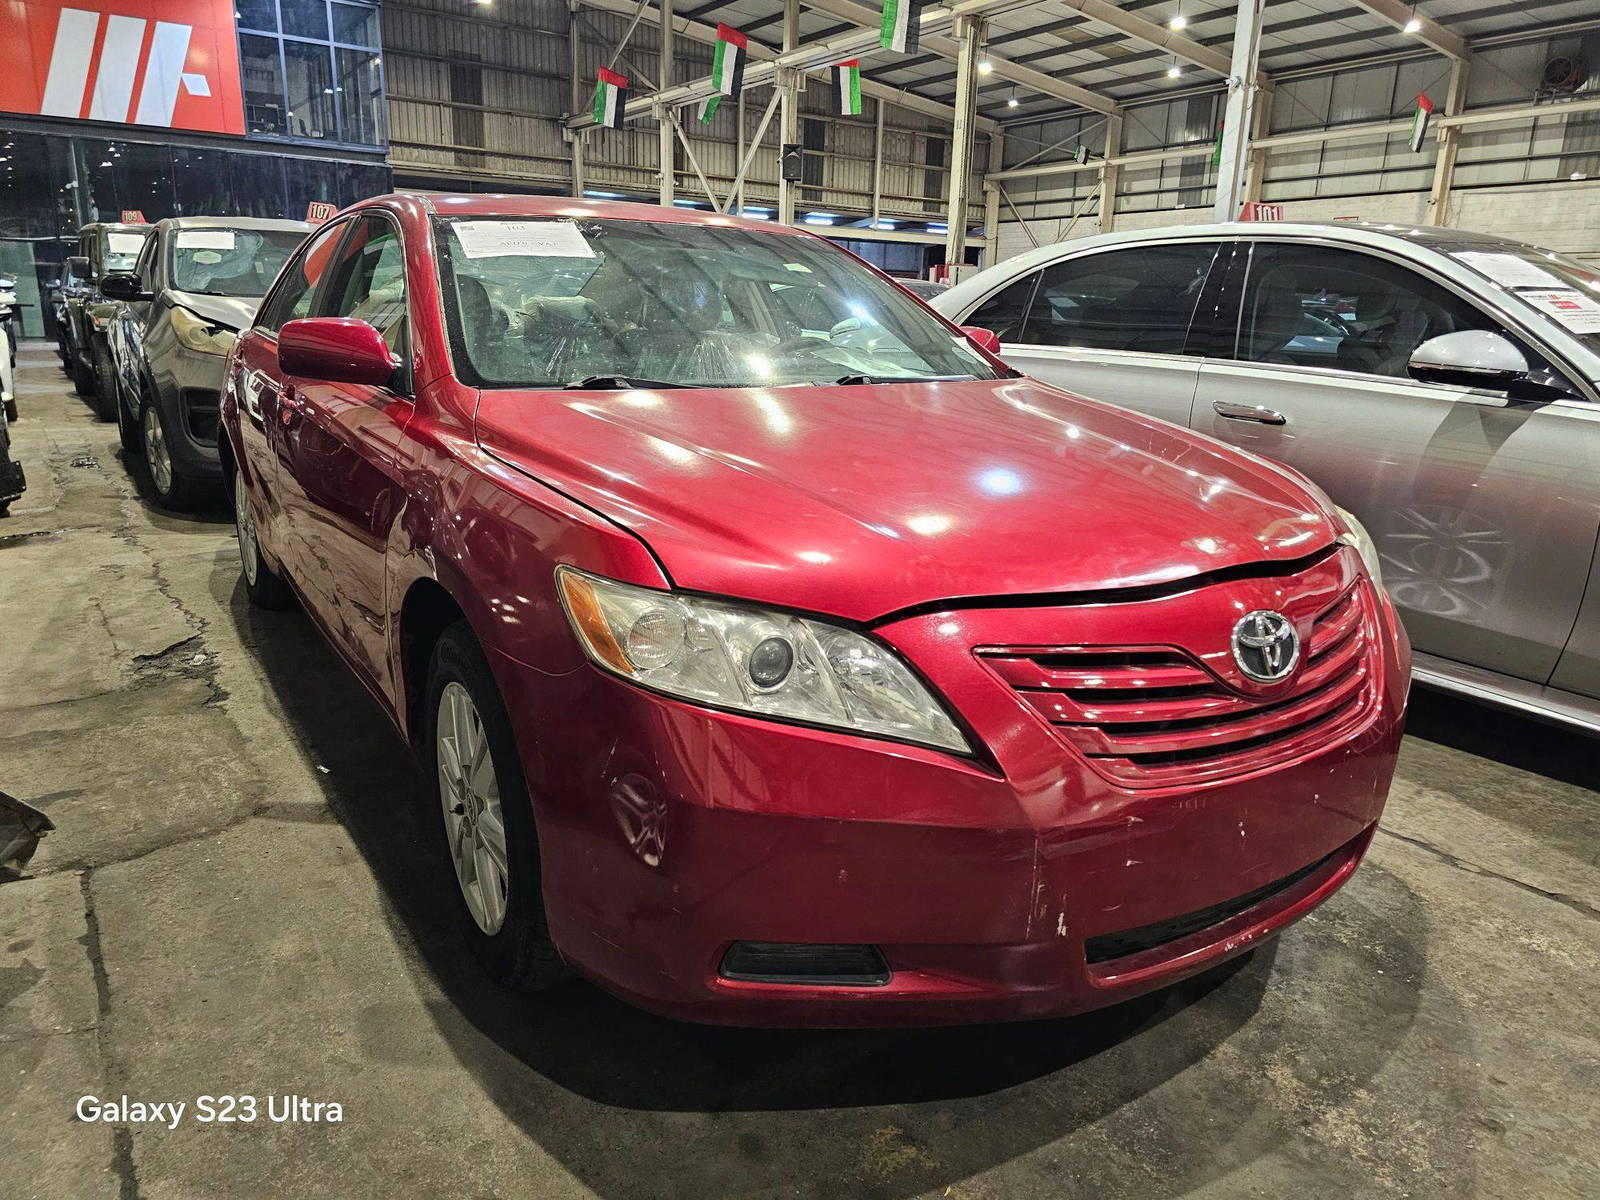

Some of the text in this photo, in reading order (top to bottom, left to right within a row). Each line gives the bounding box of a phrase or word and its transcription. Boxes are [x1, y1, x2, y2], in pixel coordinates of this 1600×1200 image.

[124, 211, 138, 222] 109
[311, 204, 330, 220] 107
[1256, 205, 1279, 221] 101
